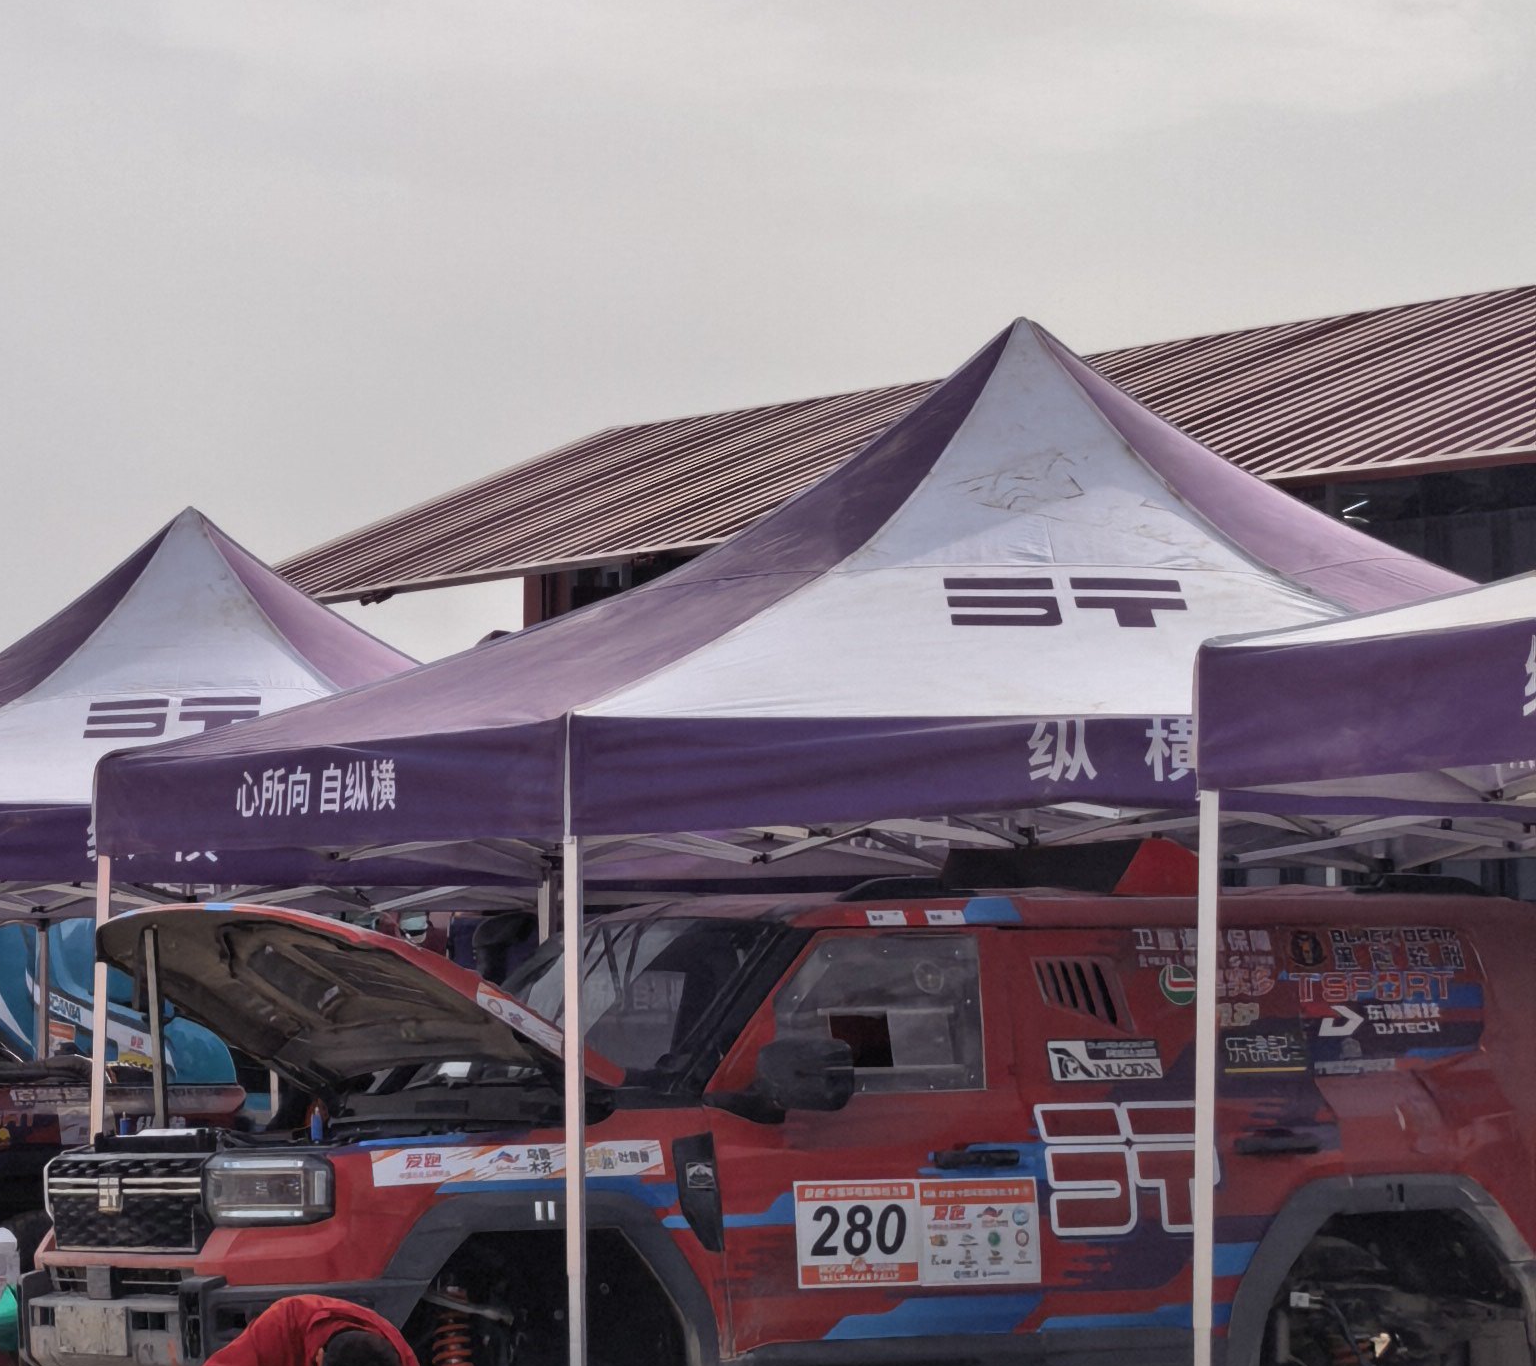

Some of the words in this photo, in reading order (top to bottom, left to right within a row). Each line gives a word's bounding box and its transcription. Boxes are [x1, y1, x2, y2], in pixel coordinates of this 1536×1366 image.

[236, 765, 311, 817] 心所向
[320, 759, 396, 813] 自纵横
[1289, 971, 1454, 1002] TSPORT
[1375, 1021, 1441, 1035] DJTECH
[810, 1203, 907, 1257] 280
